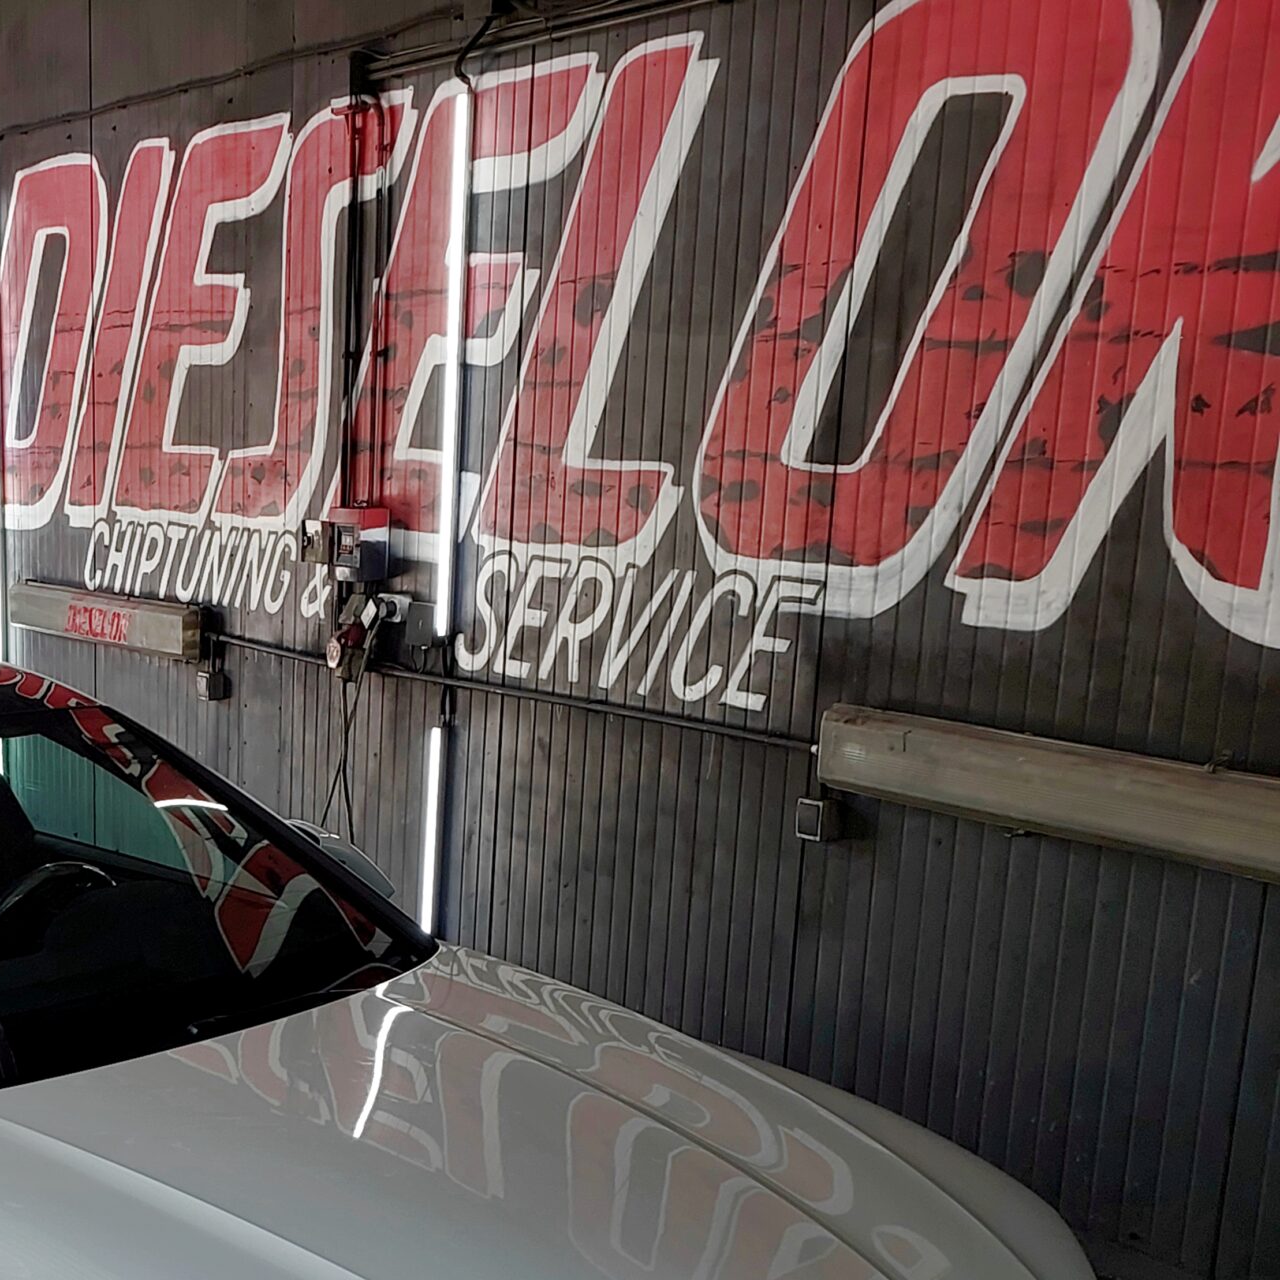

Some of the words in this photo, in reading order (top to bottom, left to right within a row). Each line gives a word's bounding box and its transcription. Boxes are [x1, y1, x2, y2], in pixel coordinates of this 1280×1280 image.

[84, 516, 297, 615] CHIPTUNING
[299, 563, 333, 620] &
[454, 549, 825, 713] SERVICE
